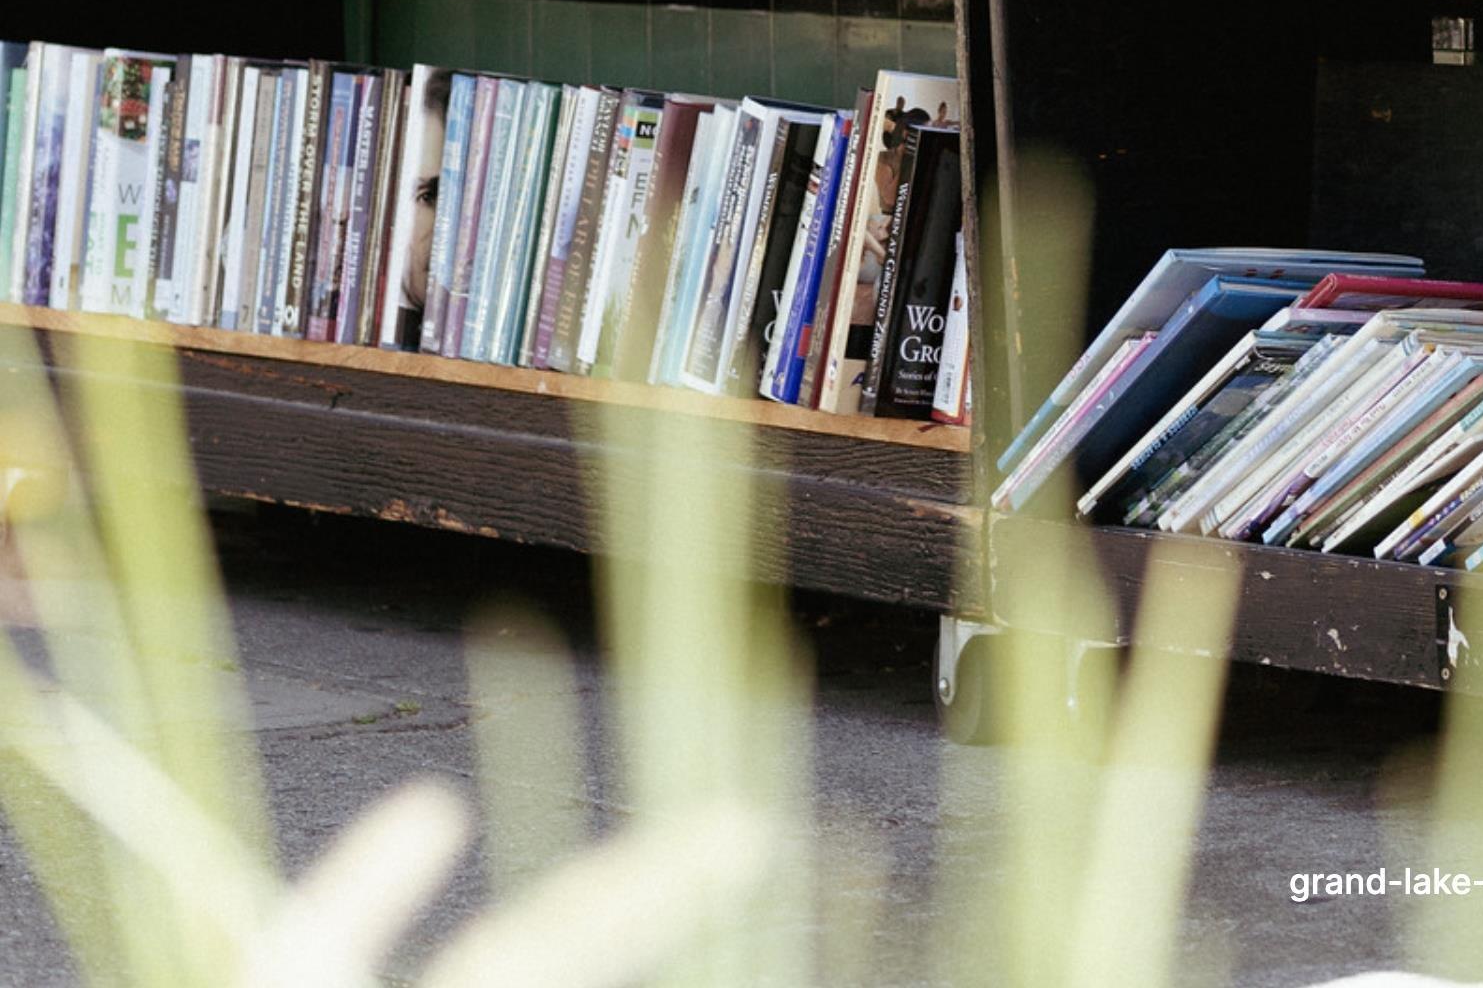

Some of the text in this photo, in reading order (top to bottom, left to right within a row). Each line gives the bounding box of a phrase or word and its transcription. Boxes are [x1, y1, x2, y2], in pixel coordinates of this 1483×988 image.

[290, 73, 324, 289] STORM OVER THE LAND
[574, 157, 601, 245] PILLAR
[758, 171, 780, 223] WOMEN
[890, 181, 909, 235] WOMEN
[567, 250, 584, 279] OF
[876, 258, 897, 317] GROUND
[870, 320, 887, 360] ZERO
